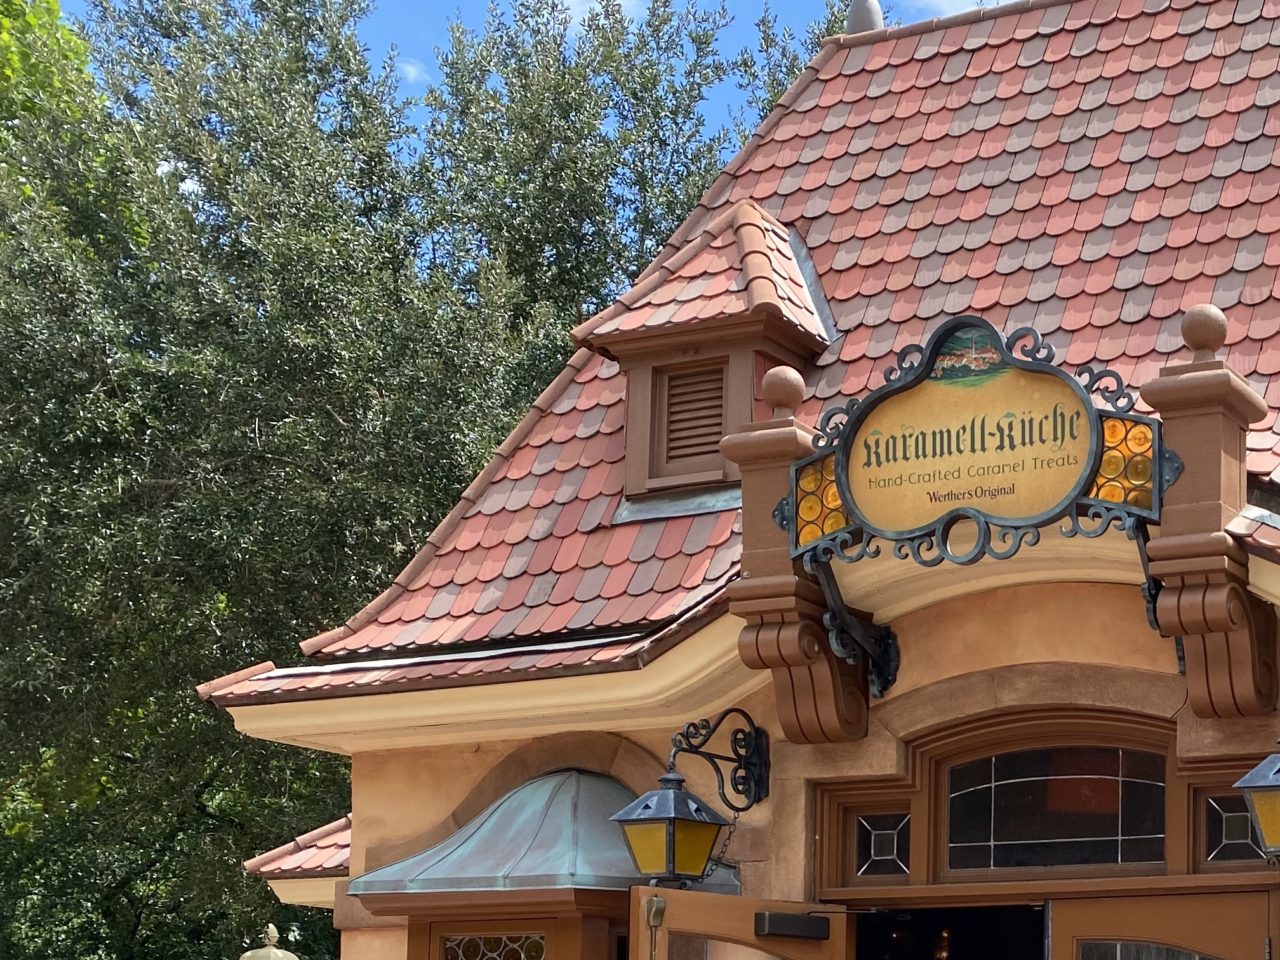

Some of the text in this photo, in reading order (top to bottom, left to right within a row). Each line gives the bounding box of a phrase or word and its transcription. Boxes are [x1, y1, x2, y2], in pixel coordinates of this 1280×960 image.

[868, 453, 1079, 490] Hand-Crafted Caramel Treats
[974, 482, 1015, 499] Original
